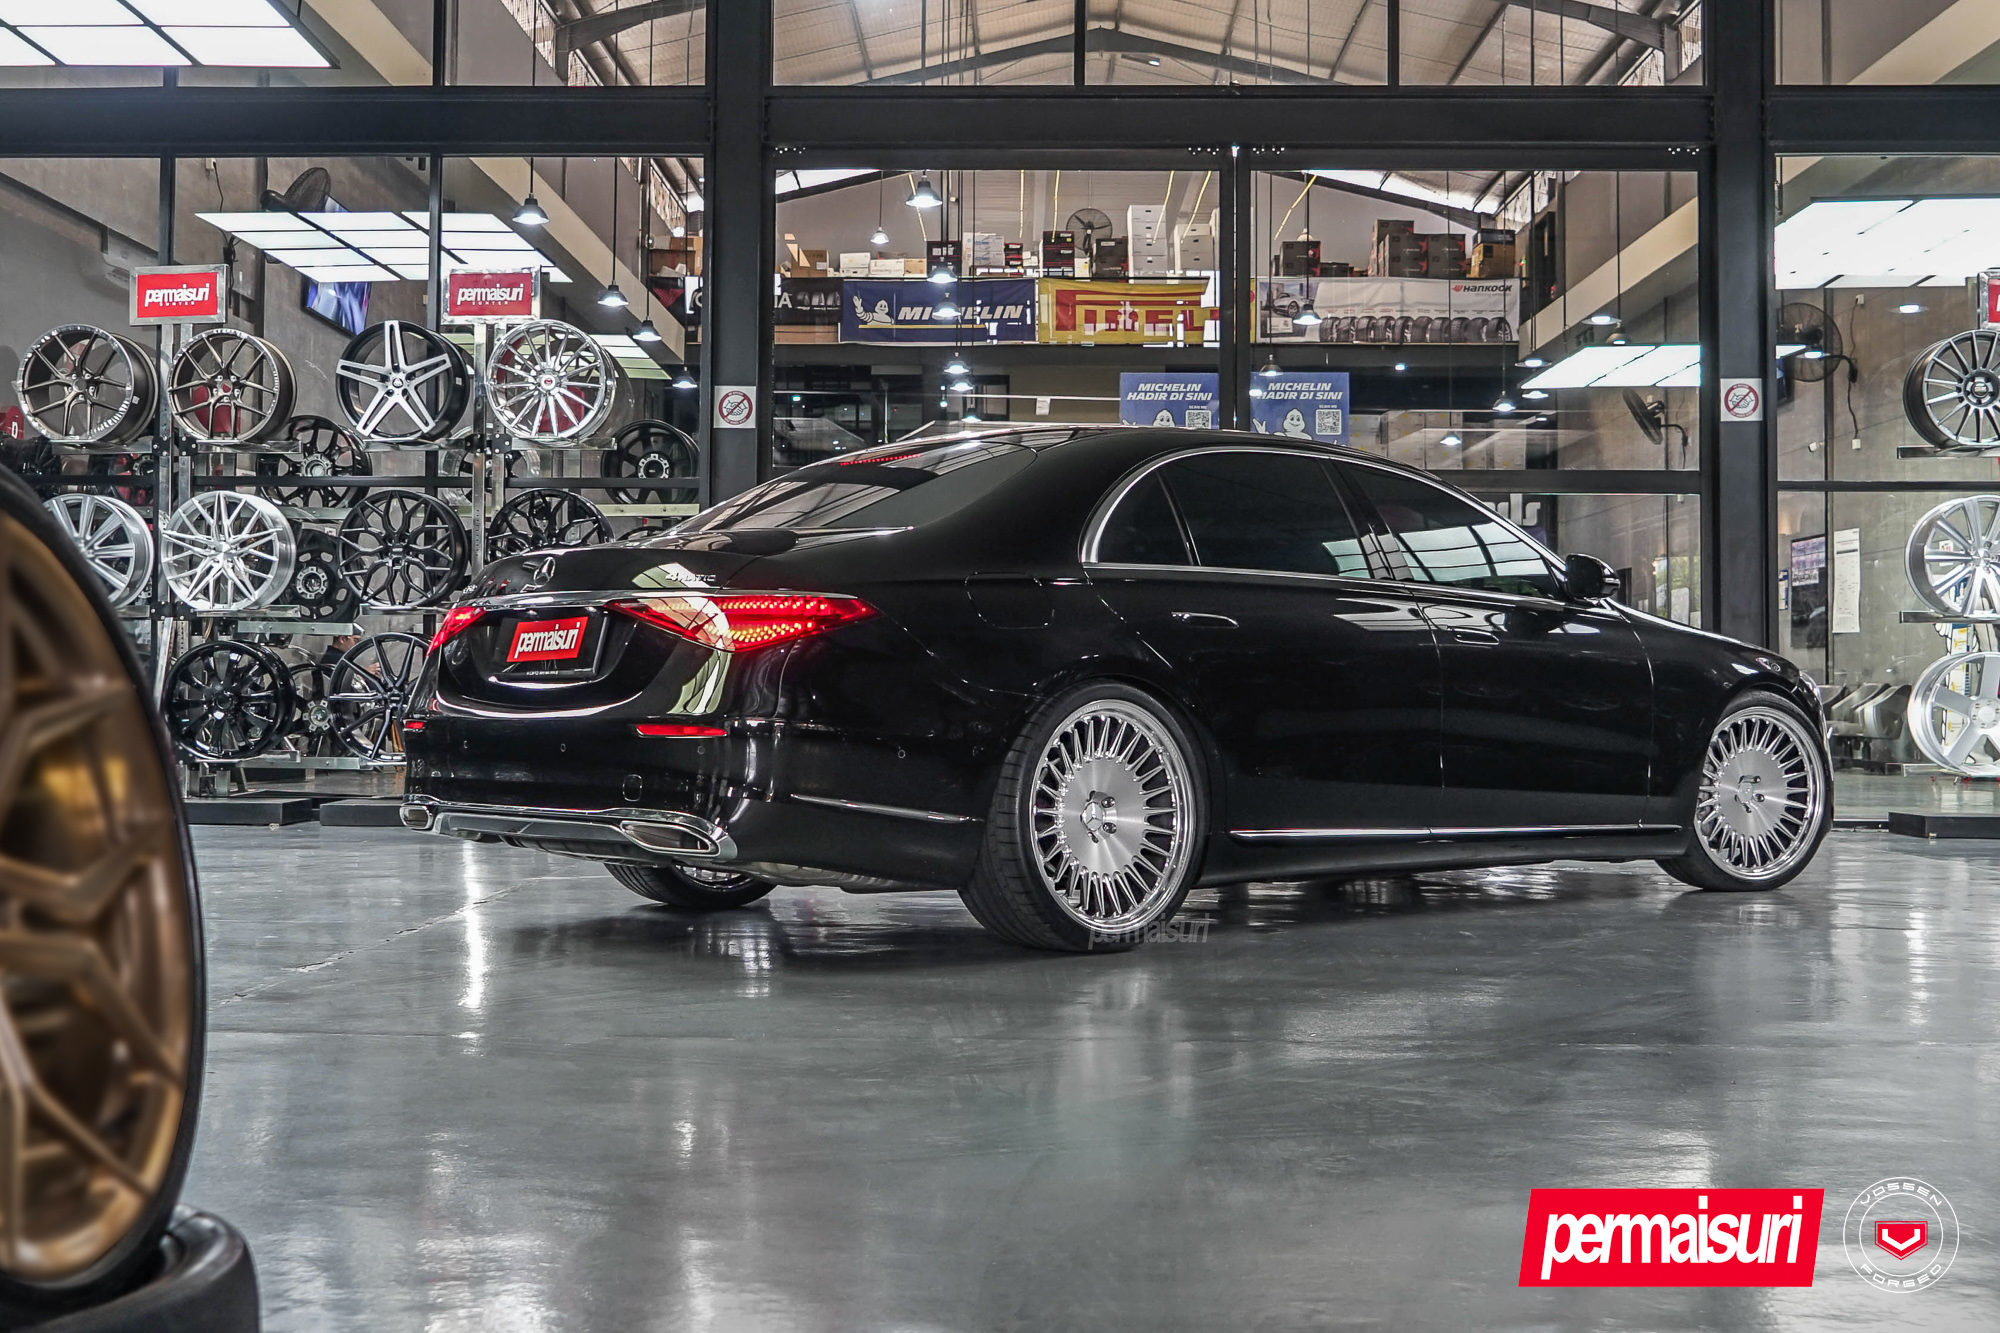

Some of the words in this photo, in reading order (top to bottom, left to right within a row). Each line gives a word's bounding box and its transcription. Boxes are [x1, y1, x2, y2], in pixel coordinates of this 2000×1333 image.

[144, 283, 210, 307] permaisuri
[456, 283, 524, 305] permaisuri
[897, 305, 1024, 320] MIELIN
[1137, 383, 1202, 392] MICHELIN
[1267, 382, 1332, 391] MICHELIN
[1126, 392, 1167, 400] HADIR
[1169, 392, 1184, 400] DI
[1185, 392, 1213, 400] SINI
[1299, 391, 1314, 400] DI
[1315, 391, 1344, 400] SINI
[514, 621, 581, 659] permaisuri
